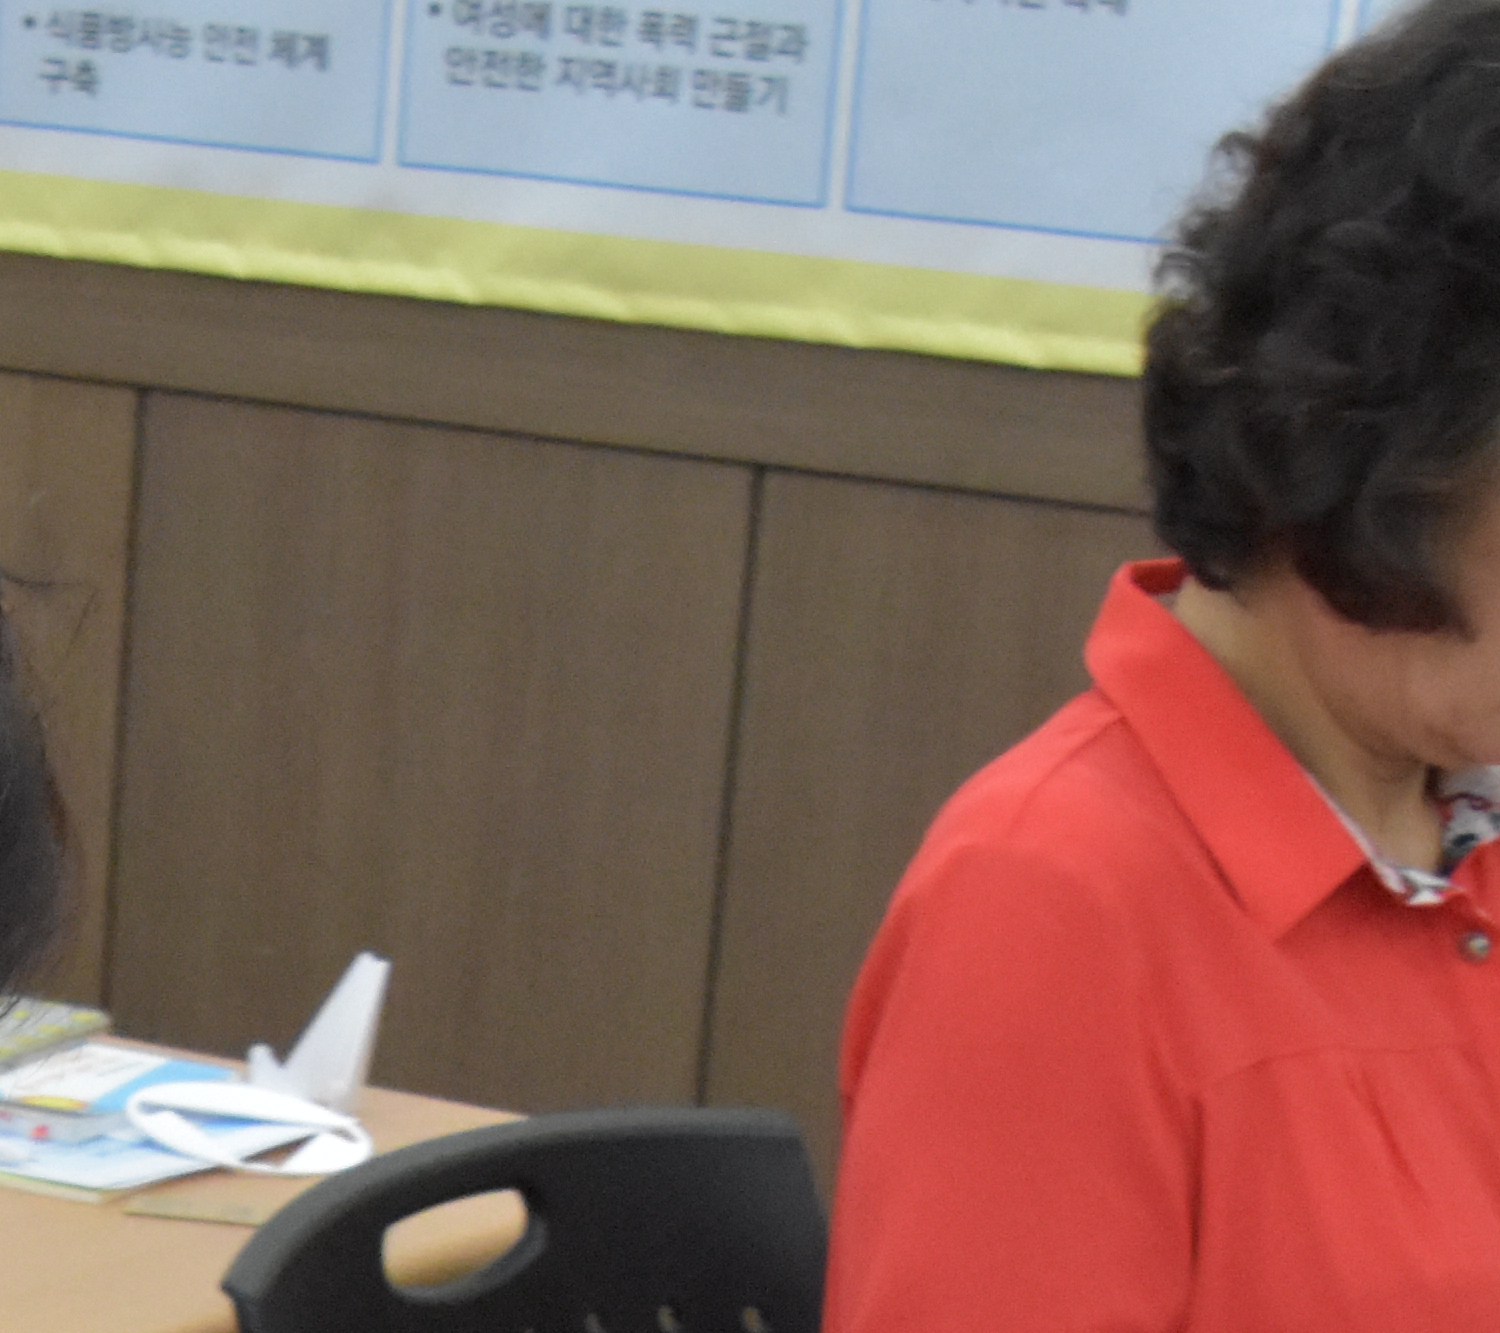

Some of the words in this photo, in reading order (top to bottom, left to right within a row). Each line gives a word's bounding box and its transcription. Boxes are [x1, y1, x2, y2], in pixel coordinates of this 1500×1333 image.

[564, 6, 629, 48] 대한
[639, 9, 699, 52] 폭력
[709, 16, 810, 64] 근절과
[445, 46, 546, 92] 안전한
[557, 54, 682, 103] 지역사회
[690, 68, 789, 116] 만들기
